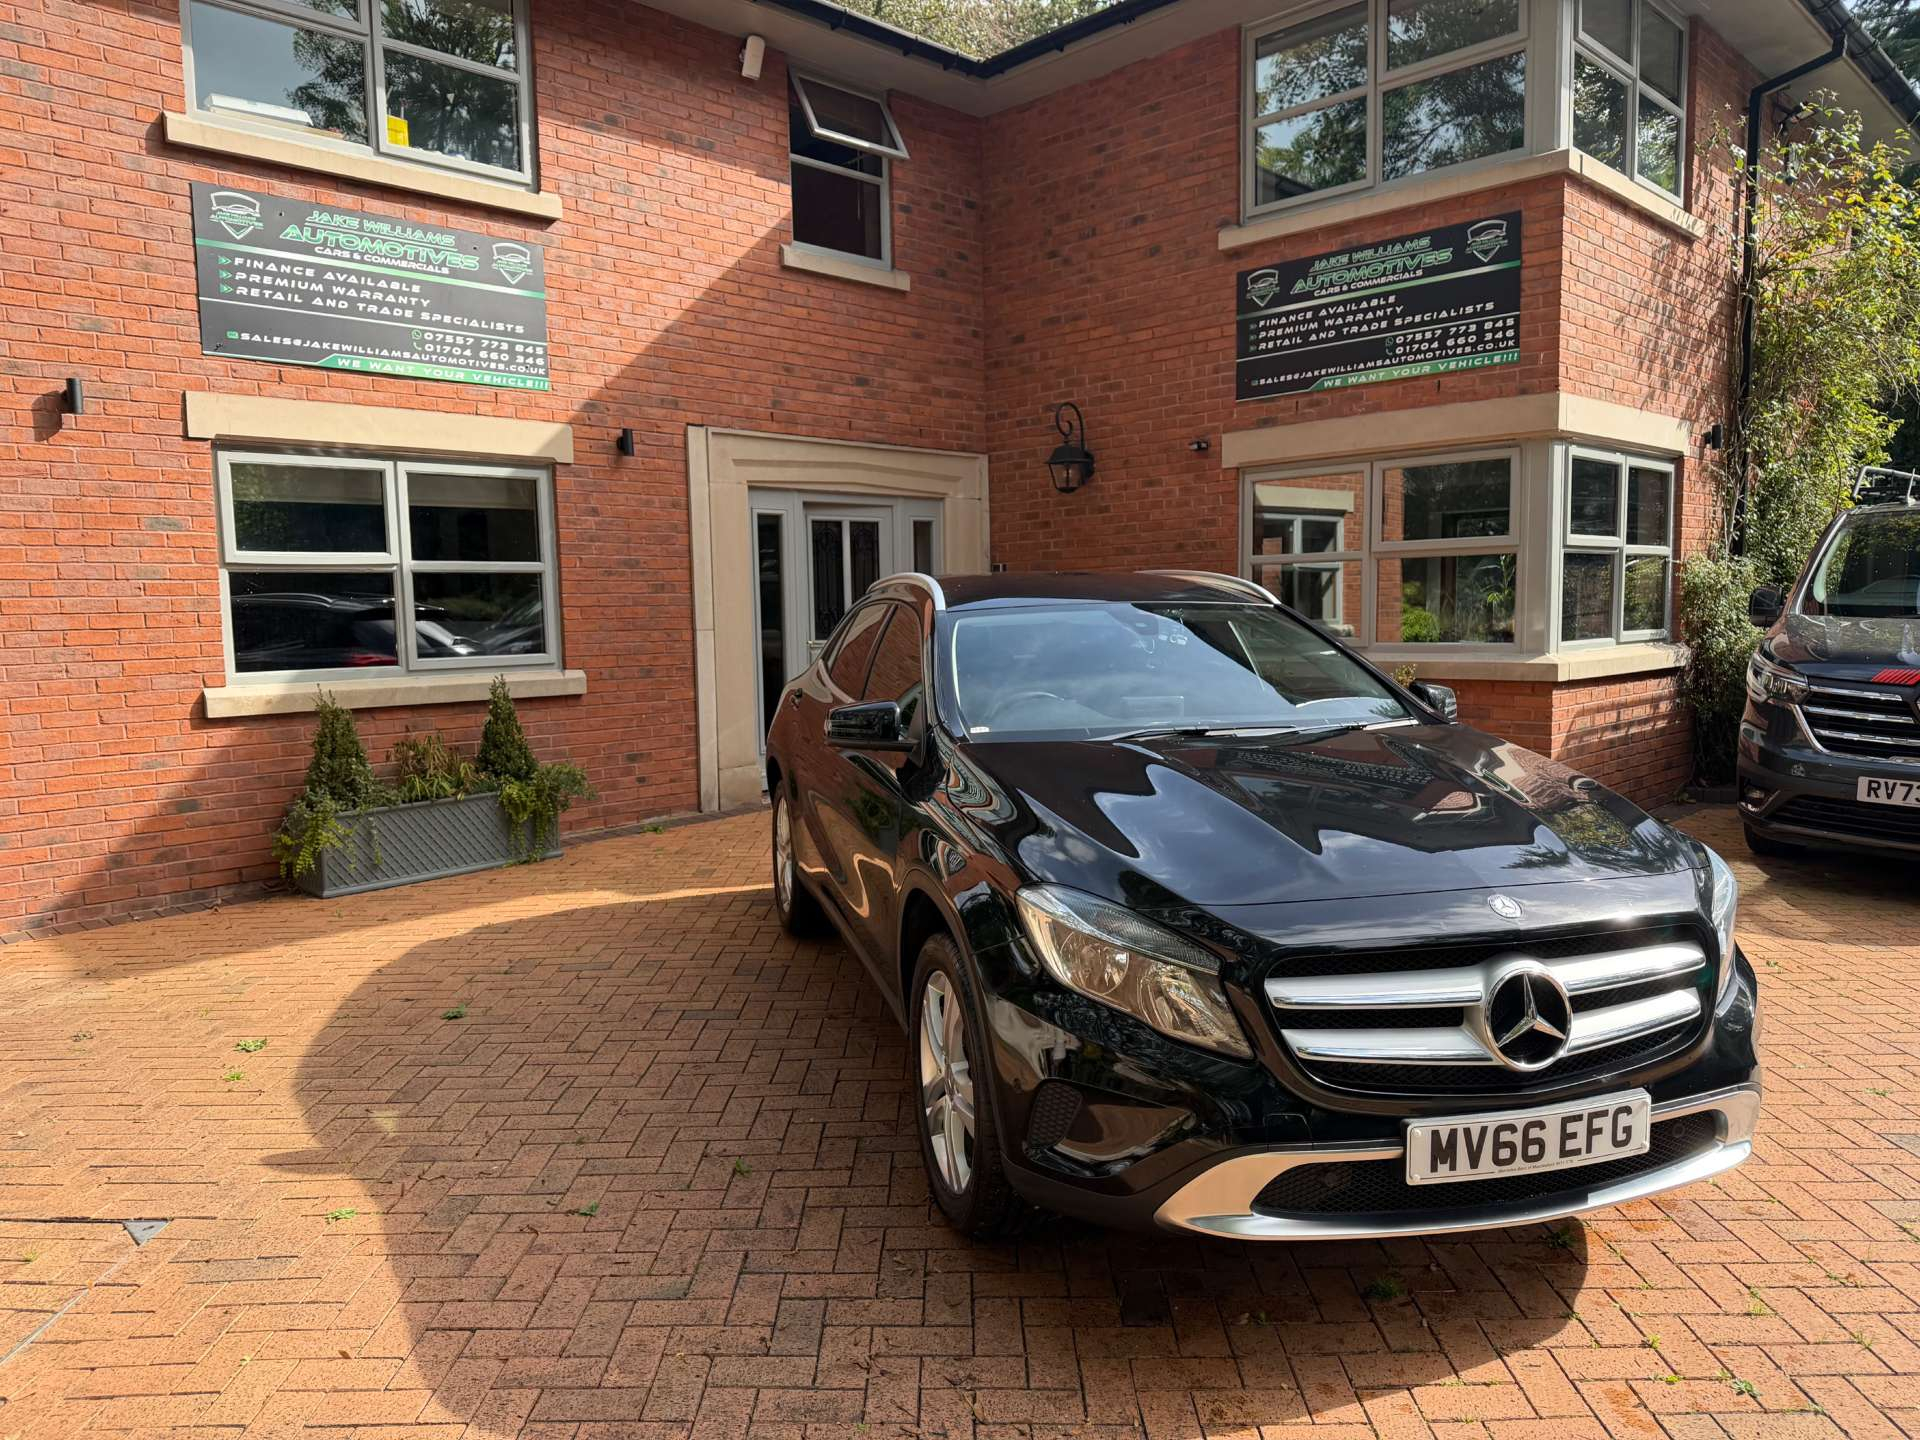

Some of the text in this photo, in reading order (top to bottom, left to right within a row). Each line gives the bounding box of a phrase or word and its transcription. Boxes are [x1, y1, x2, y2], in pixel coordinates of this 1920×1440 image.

[305, 211, 457, 246] JAKE WILLIAMS
[279, 224, 480, 271] AUTOMOTIVES
[314, 246, 450, 274] CARS & COMMERCIALS
[1309, 236, 1431, 272] JAKE WILLIAMS
[234, 257, 421, 293] FINANCE AVAILABLE
[1290, 247, 1453, 294] AUTOMOTIVES
[1314, 286, 1340, 297] CARS
[1350, 269, 1423, 290] COMMERCIALS
[235, 271, 431, 307] PREMIUM WARRANTY
[236, 286, 525, 334] RETAIL AND TRADE SPECIALISTS
[1258, 295, 1397, 328] FINANCE AVAILABLE
[1258, 305, 1404, 339] PREMIUM WARRANTY
[1258, 302, 1495, 351] RETAIL AND TRADE SPECIALISTS
[424, 332, 544, 355] 07557 773 845
[1395, 318, 1515, 344] 07557 773 845
[1395, 329, 1515, 355] 01704 660 346
[240, 332, 546, 375] SALES@JAKEWILLIAMSAUTOMOTIVES.CO.UK
[424, 343, 545, 366] 01704 660 346
[1259, 339, 1516, 385] SALES@JAKEWILLIAMSAUTOMOTIVES.CO.UK
[1323, 352, 1518, 389] WE WANT YOUR VEHICLE!!!
[336, 358, 548, 389] WE WANT YOUR VEHICLE!!!
[1429, 1105, 1633, 1174] MV66 EFG
